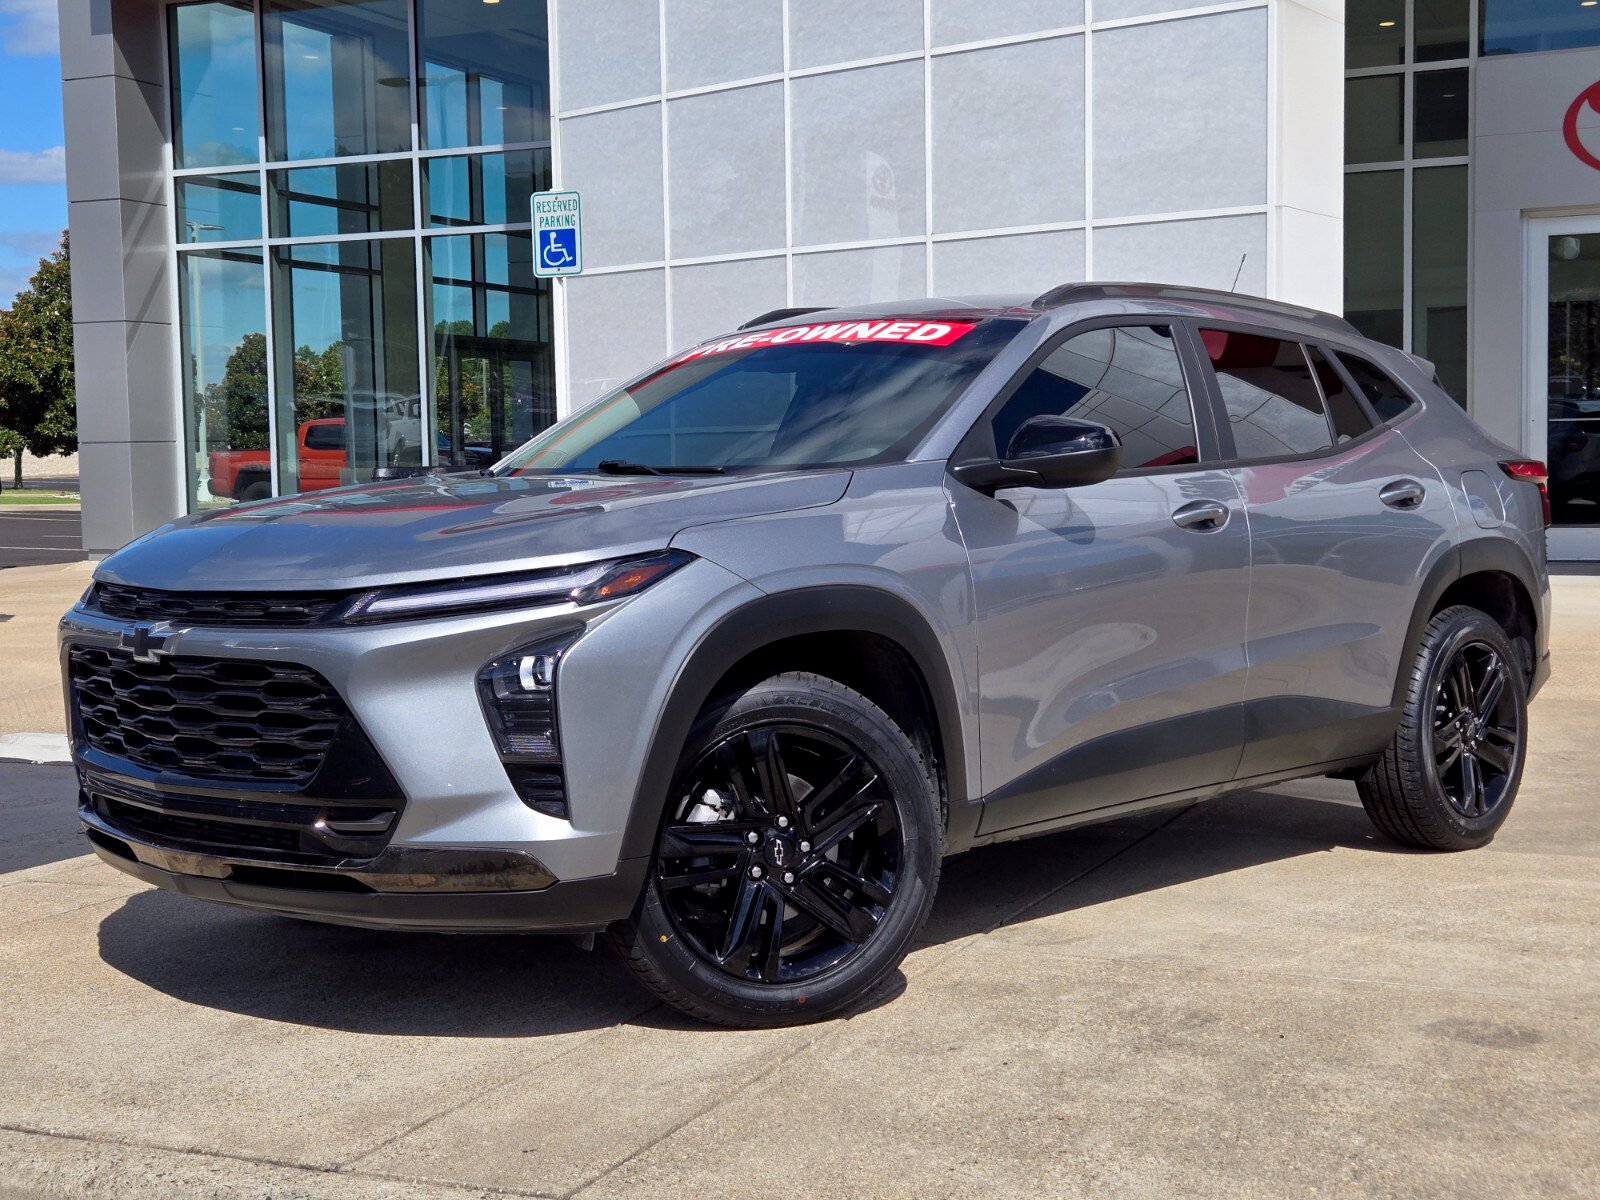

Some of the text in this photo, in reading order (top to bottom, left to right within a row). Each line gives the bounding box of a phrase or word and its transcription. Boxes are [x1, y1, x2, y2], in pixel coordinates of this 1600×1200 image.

[536, 199, 578, 213] RESERVED
[539, 214, 576, 228] PARKING
[677, 322, 952, 363] PRE-OWNED
